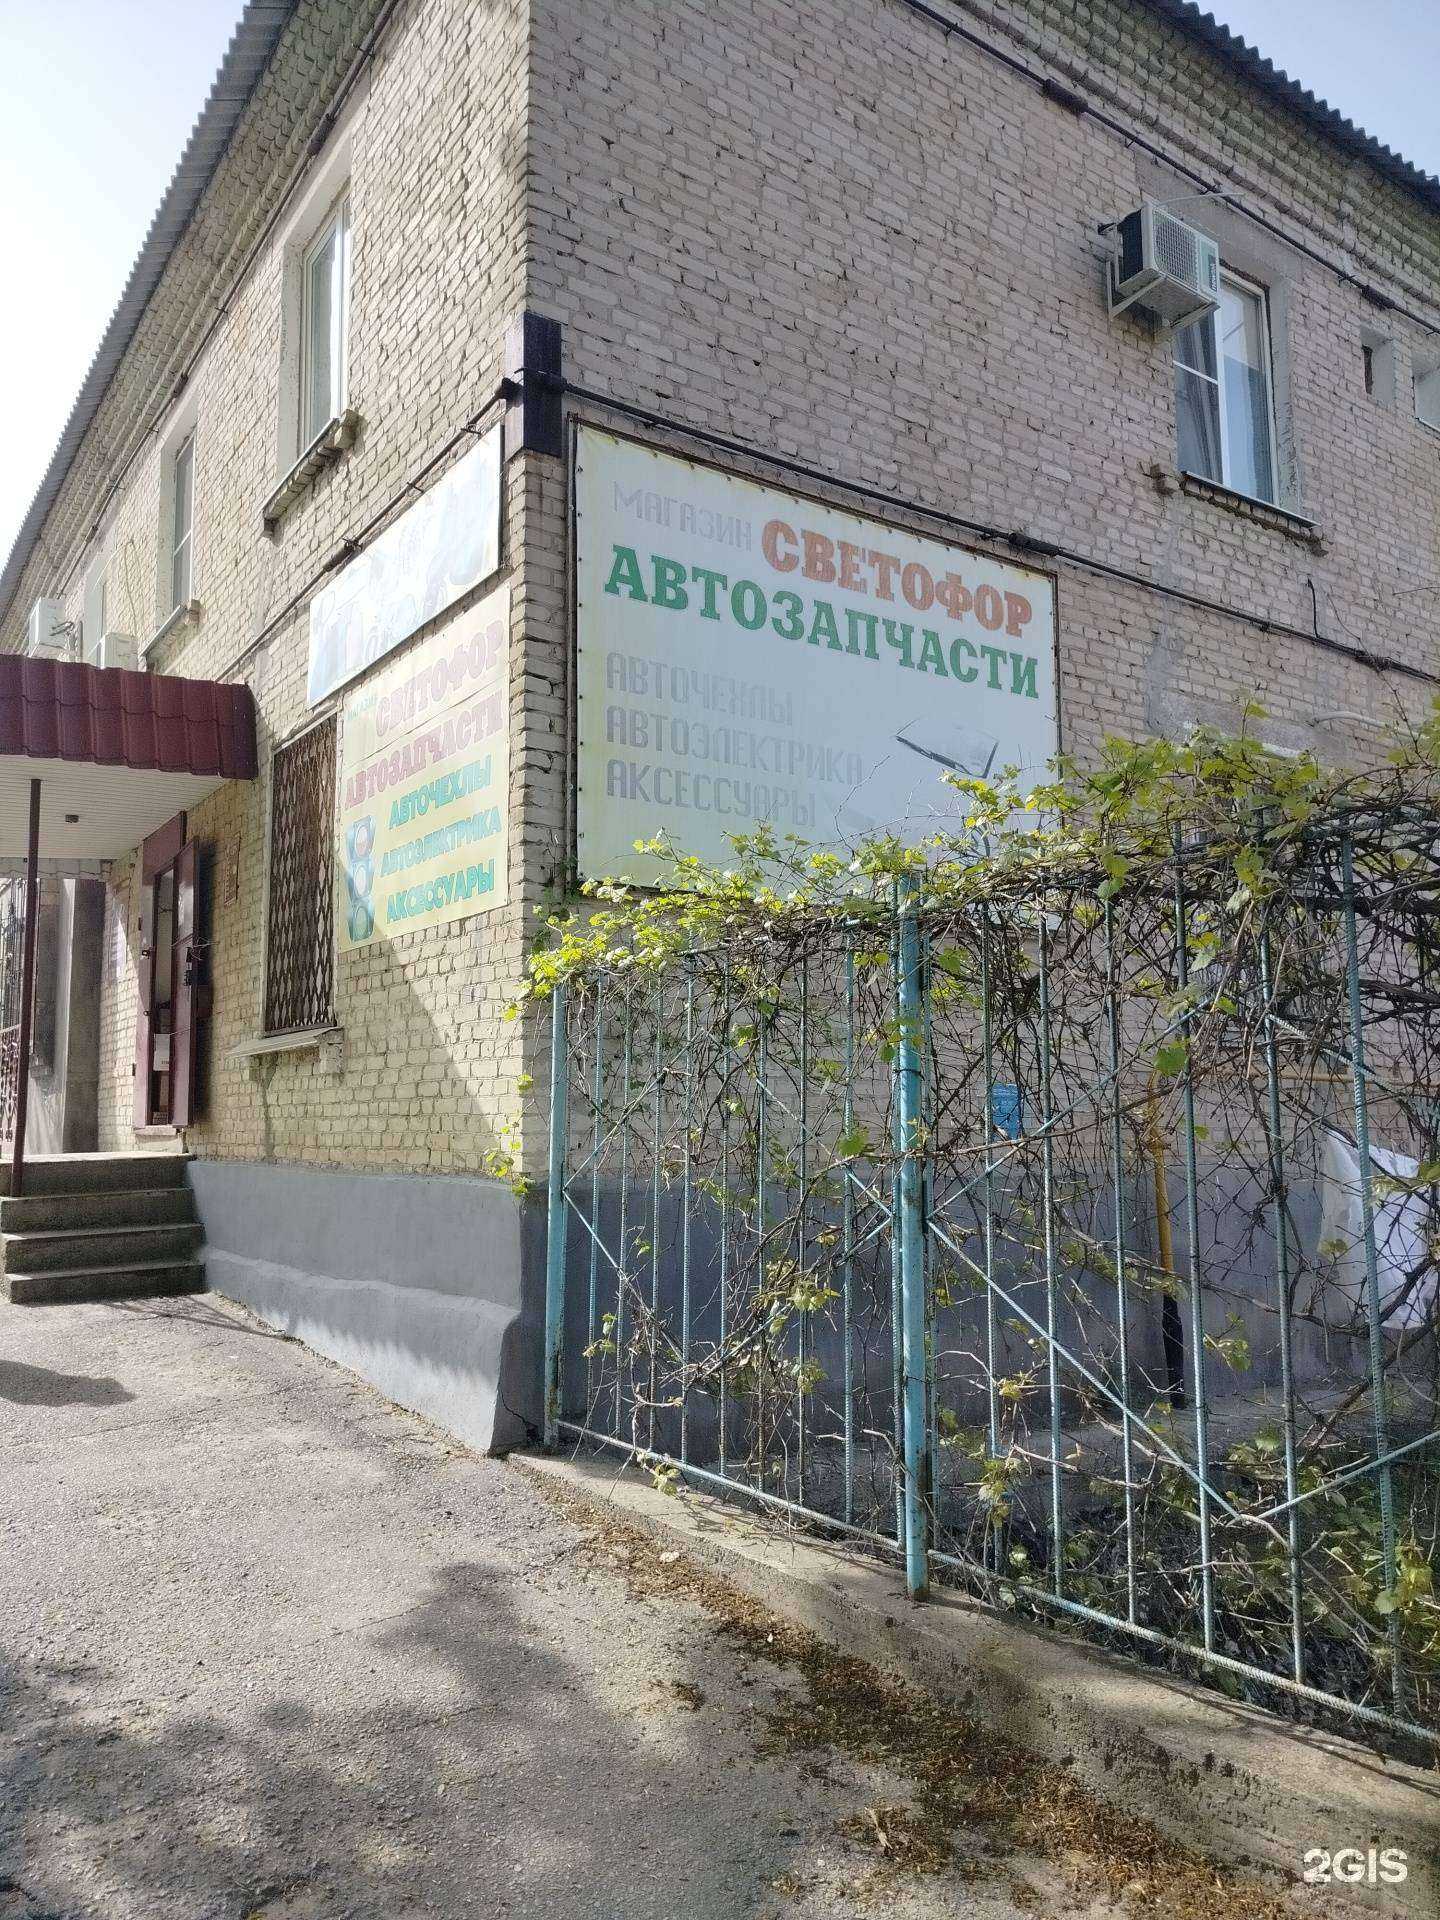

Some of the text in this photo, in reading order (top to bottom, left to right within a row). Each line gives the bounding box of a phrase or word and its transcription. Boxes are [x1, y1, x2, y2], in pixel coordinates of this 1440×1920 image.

[613, 481, 1033, 637] МАГАЗИН СВЕТОФОР
[604, 544, 1039, 699] АВТОЗАПЧАСТИ
[345, 688, 502, 811] АВТОЗАПЧАСТИ
[606, 705, 864, 785] АВТОЭЛЕКТРИКА
[389, 754, 491, 830] АВТОЧЕХЛЫ
[606, 759, 817, 828] АКСЕССУАРЫ
[387, 859, 495, 924] АКСЕССУАРЫ
